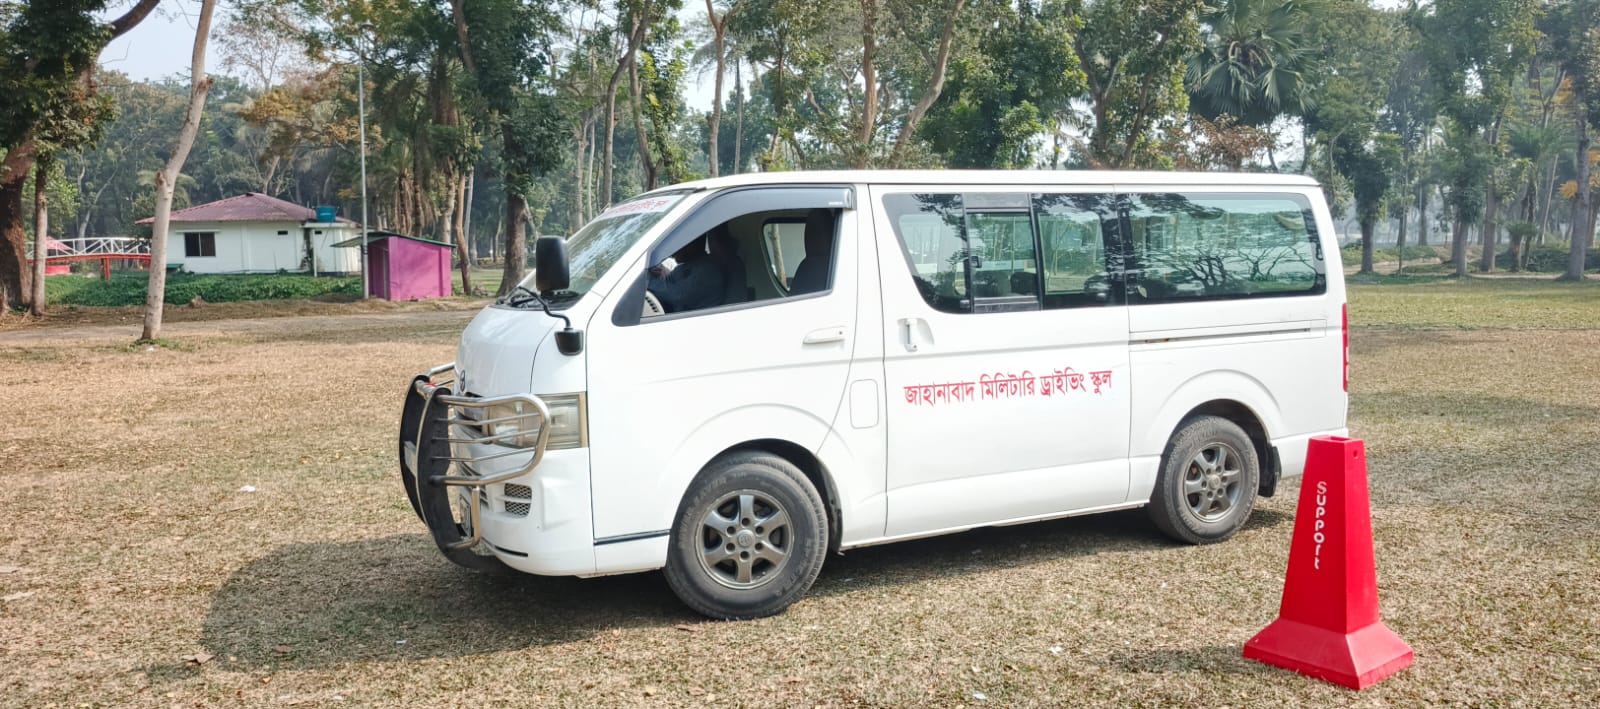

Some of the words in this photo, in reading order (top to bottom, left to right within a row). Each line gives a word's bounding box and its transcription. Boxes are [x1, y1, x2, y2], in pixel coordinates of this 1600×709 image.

[904, 381, 976, 407] জাহানাবাদ
[979, 370, 1037, 401] মিলিটারি
[1040, 366, 1087, 398] ড্রাইভিং
[1089, 370, 1113, 396] স্কুল
